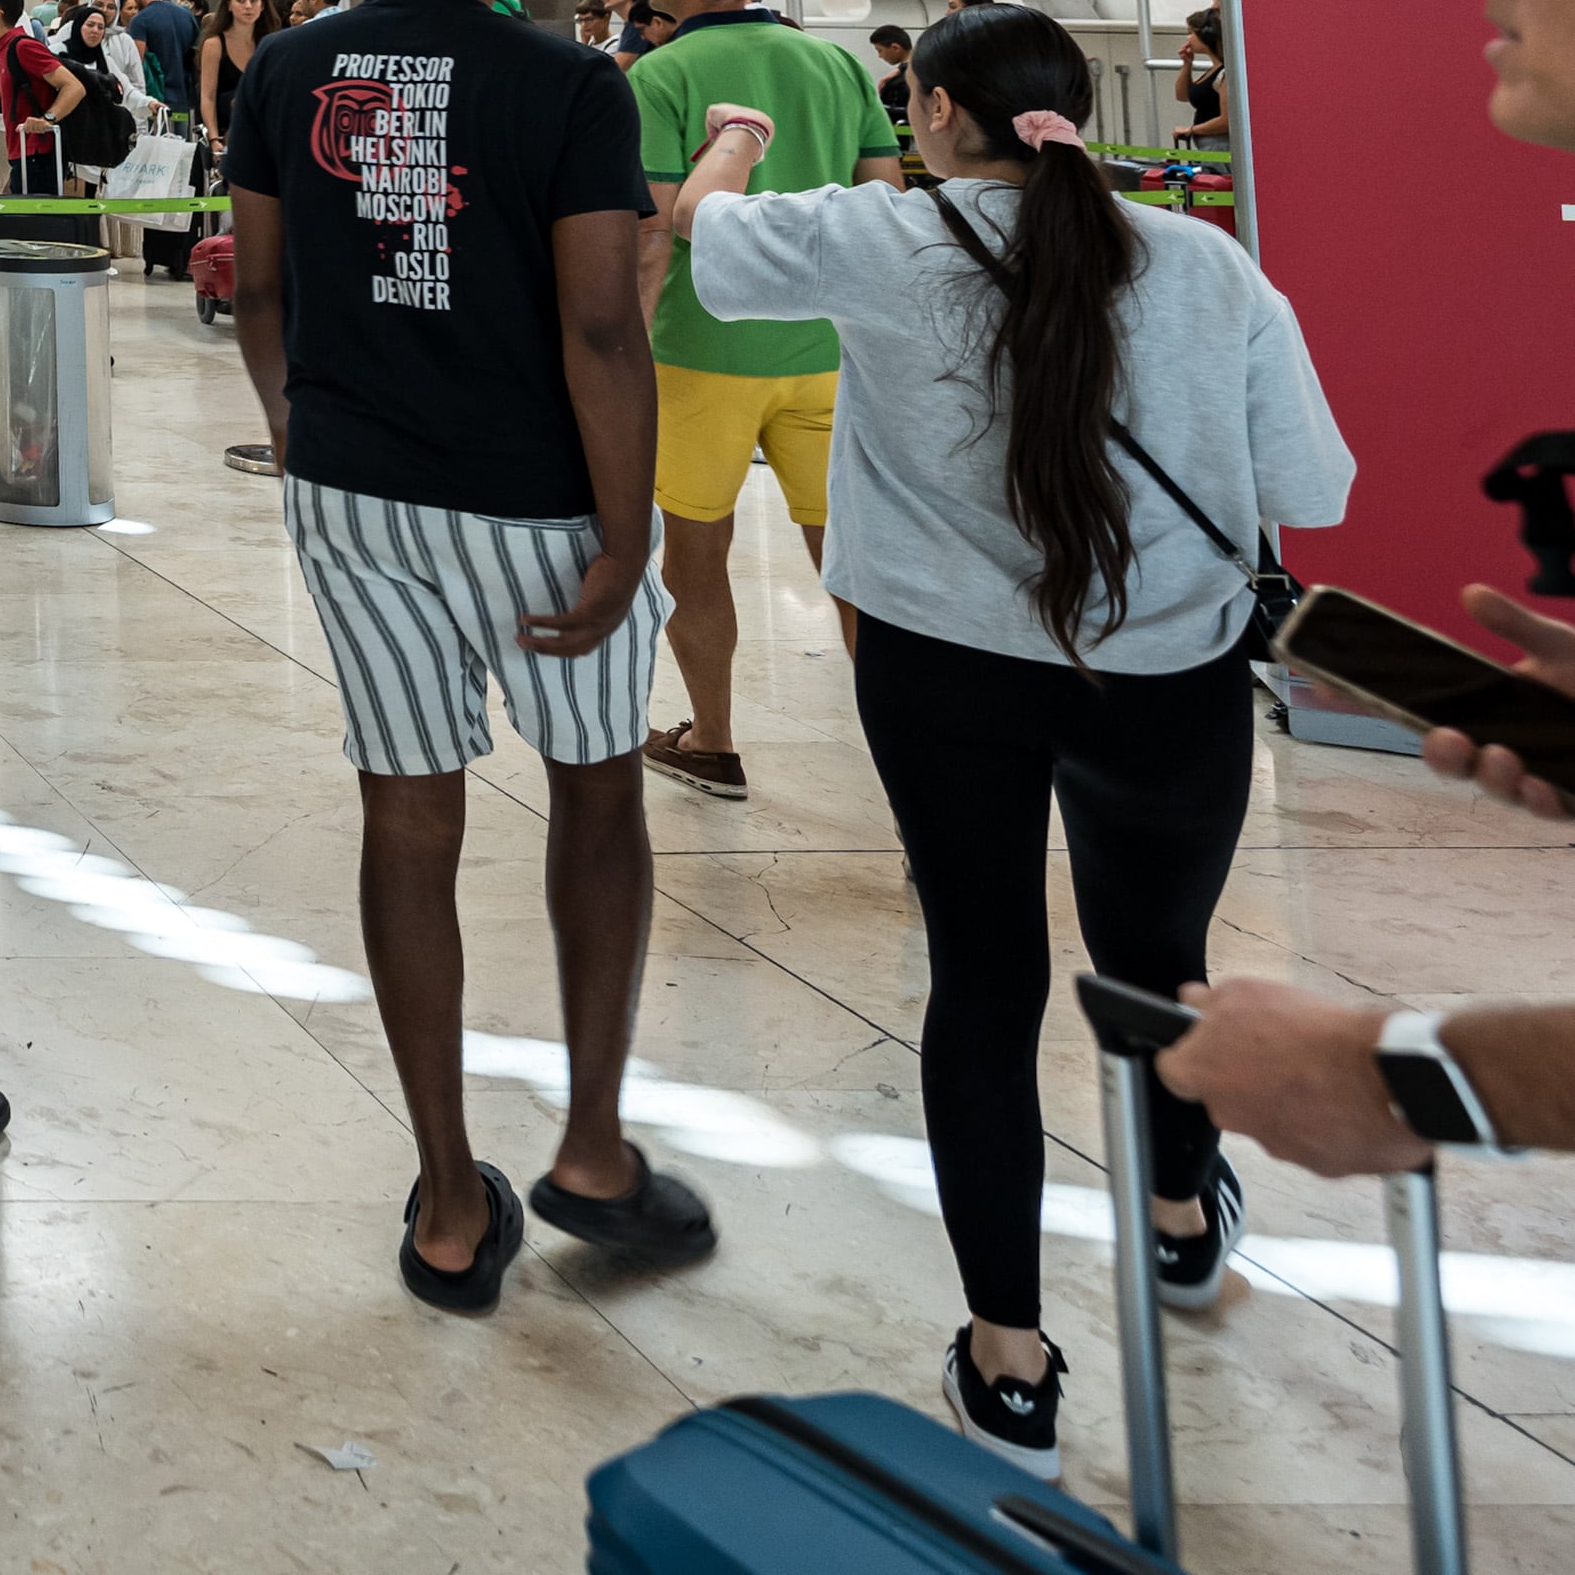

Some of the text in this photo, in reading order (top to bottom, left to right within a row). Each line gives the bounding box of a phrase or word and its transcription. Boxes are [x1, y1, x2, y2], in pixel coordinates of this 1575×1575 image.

[331, 53, 455, 82] PROFESSOR
[388, 83, 451, 109] TOKIO
[375, 109, 448, 138] BERLIN
[350, 136, 447, 167] HELSINKI
[361, 165, 447, 195] NAIROBI
[355, 191, 447, 222] MOSCOW
[413, 223, 449, 251] RIO
[394, 251, 450, 281] OSLO
[371, 275, 451, 311] DENVER
